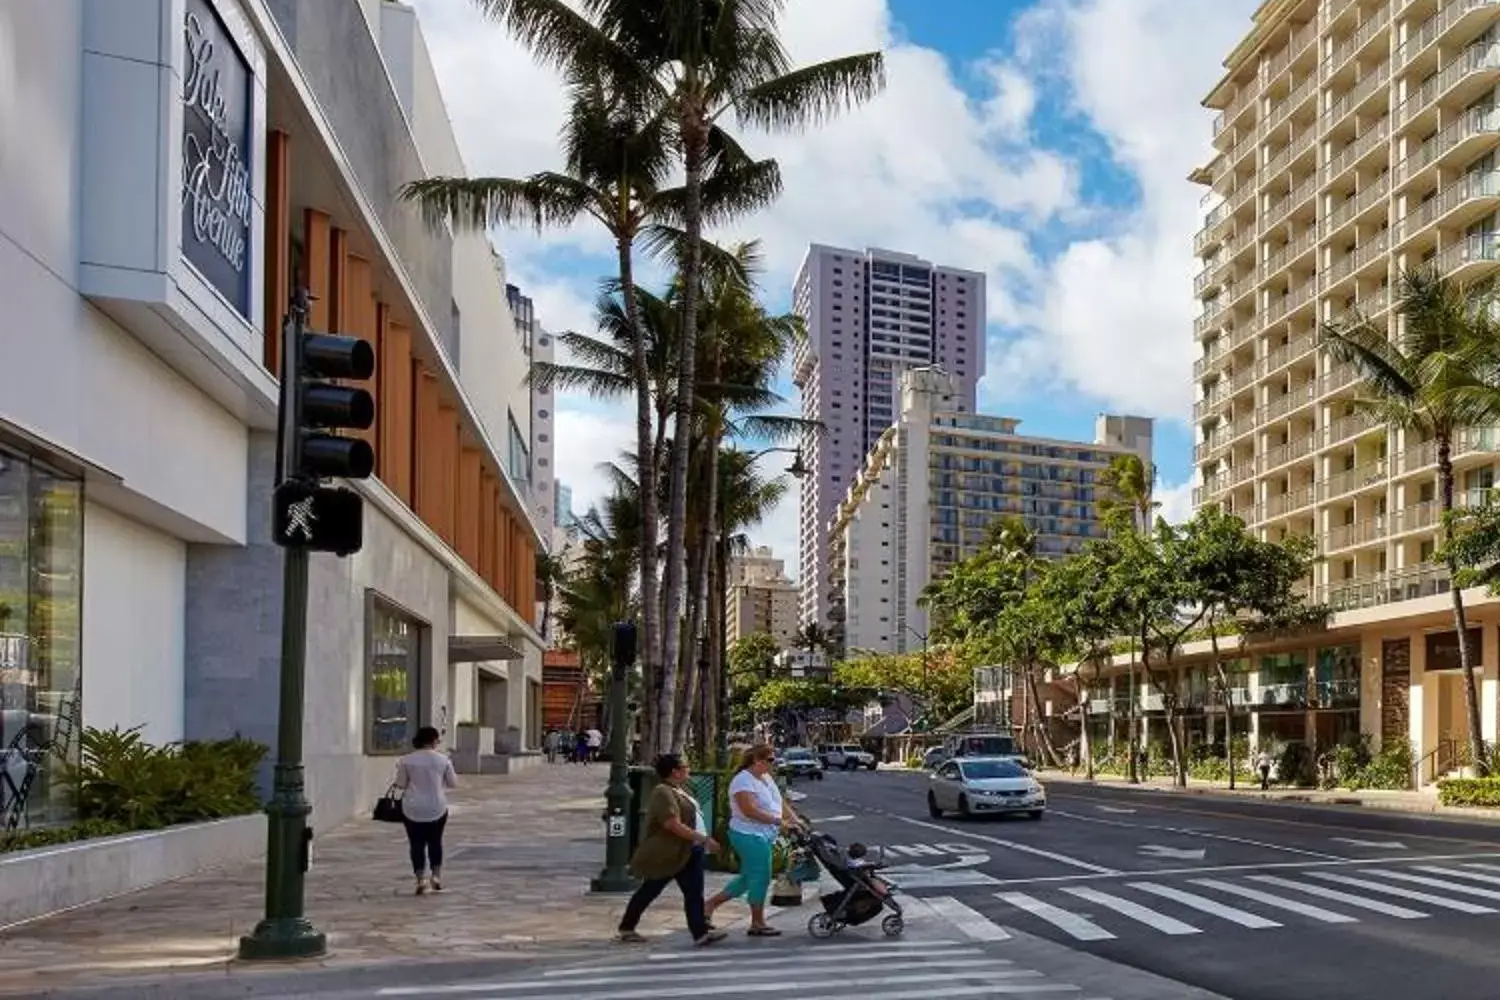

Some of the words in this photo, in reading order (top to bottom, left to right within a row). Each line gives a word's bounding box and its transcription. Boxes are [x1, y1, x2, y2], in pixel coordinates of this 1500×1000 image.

[180, 12, 229, 155] Saks
[180, 133, 245, 272] Avenue
[206, 143, 251, 227] Fifth
